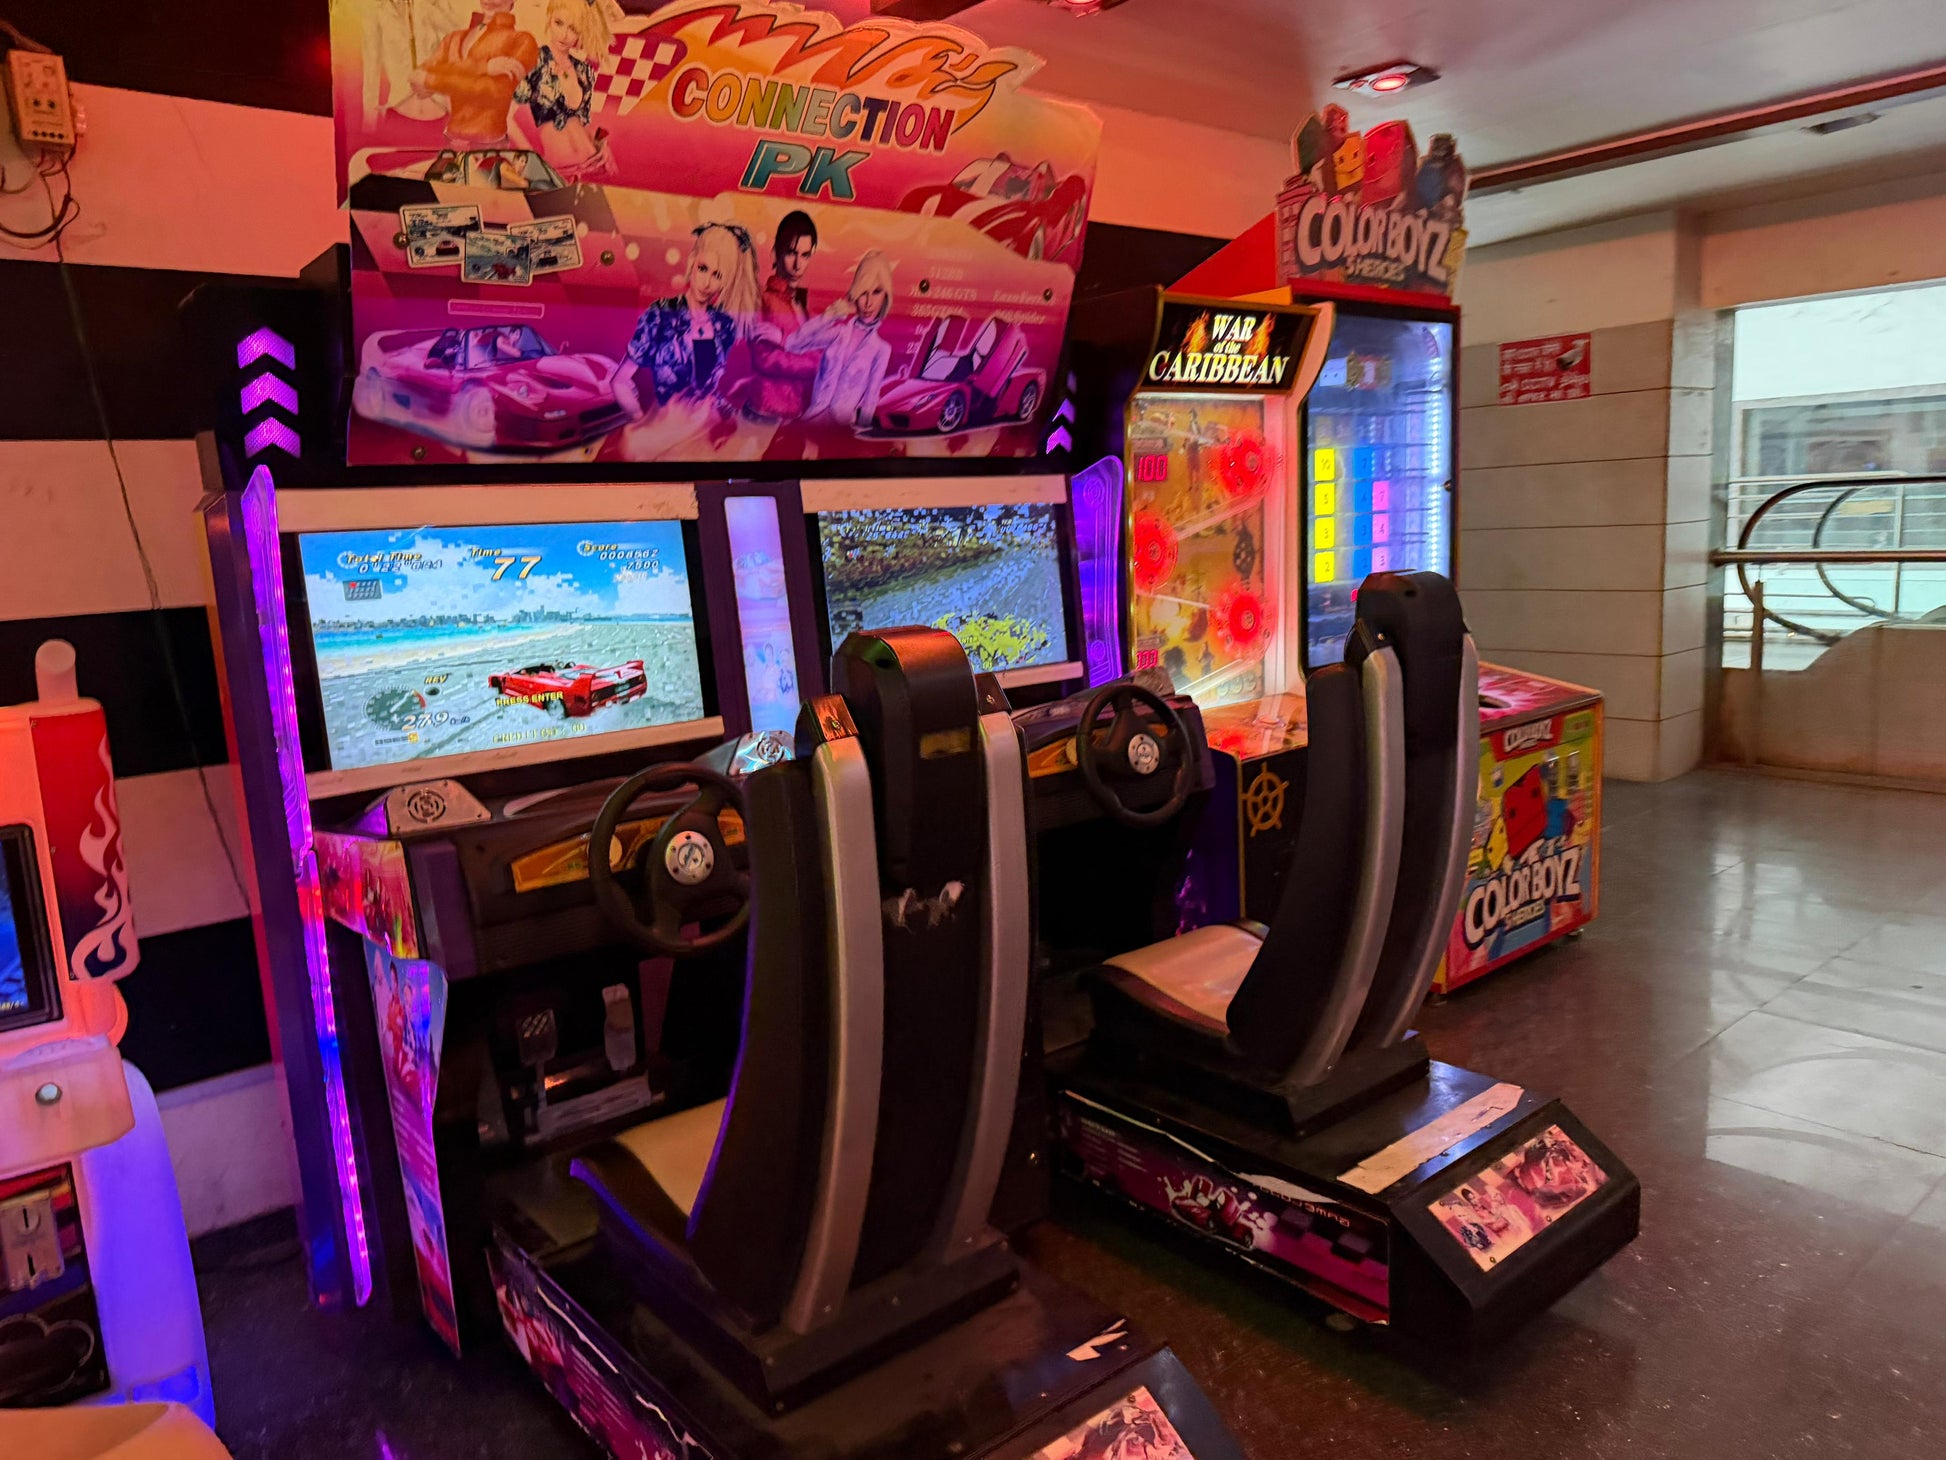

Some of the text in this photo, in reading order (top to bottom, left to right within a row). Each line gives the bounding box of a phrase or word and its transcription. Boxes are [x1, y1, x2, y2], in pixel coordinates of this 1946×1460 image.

[671, 67, 956, 152] CONNECTION
[740, 139, 871, 200] PK
[1212, 314, 1257, 342] WAR
[1213, 341, 1242, 354] of the
[1148, 350, 1291, 385] CARIBBEAN
[1137, 454, 1169, 482] 100
[389, 551, 423, 563] Time
[470, 547, 502, 558] Time
[491, 555, 543, 581] 77
[530, 691, 564, 703] ENTER
